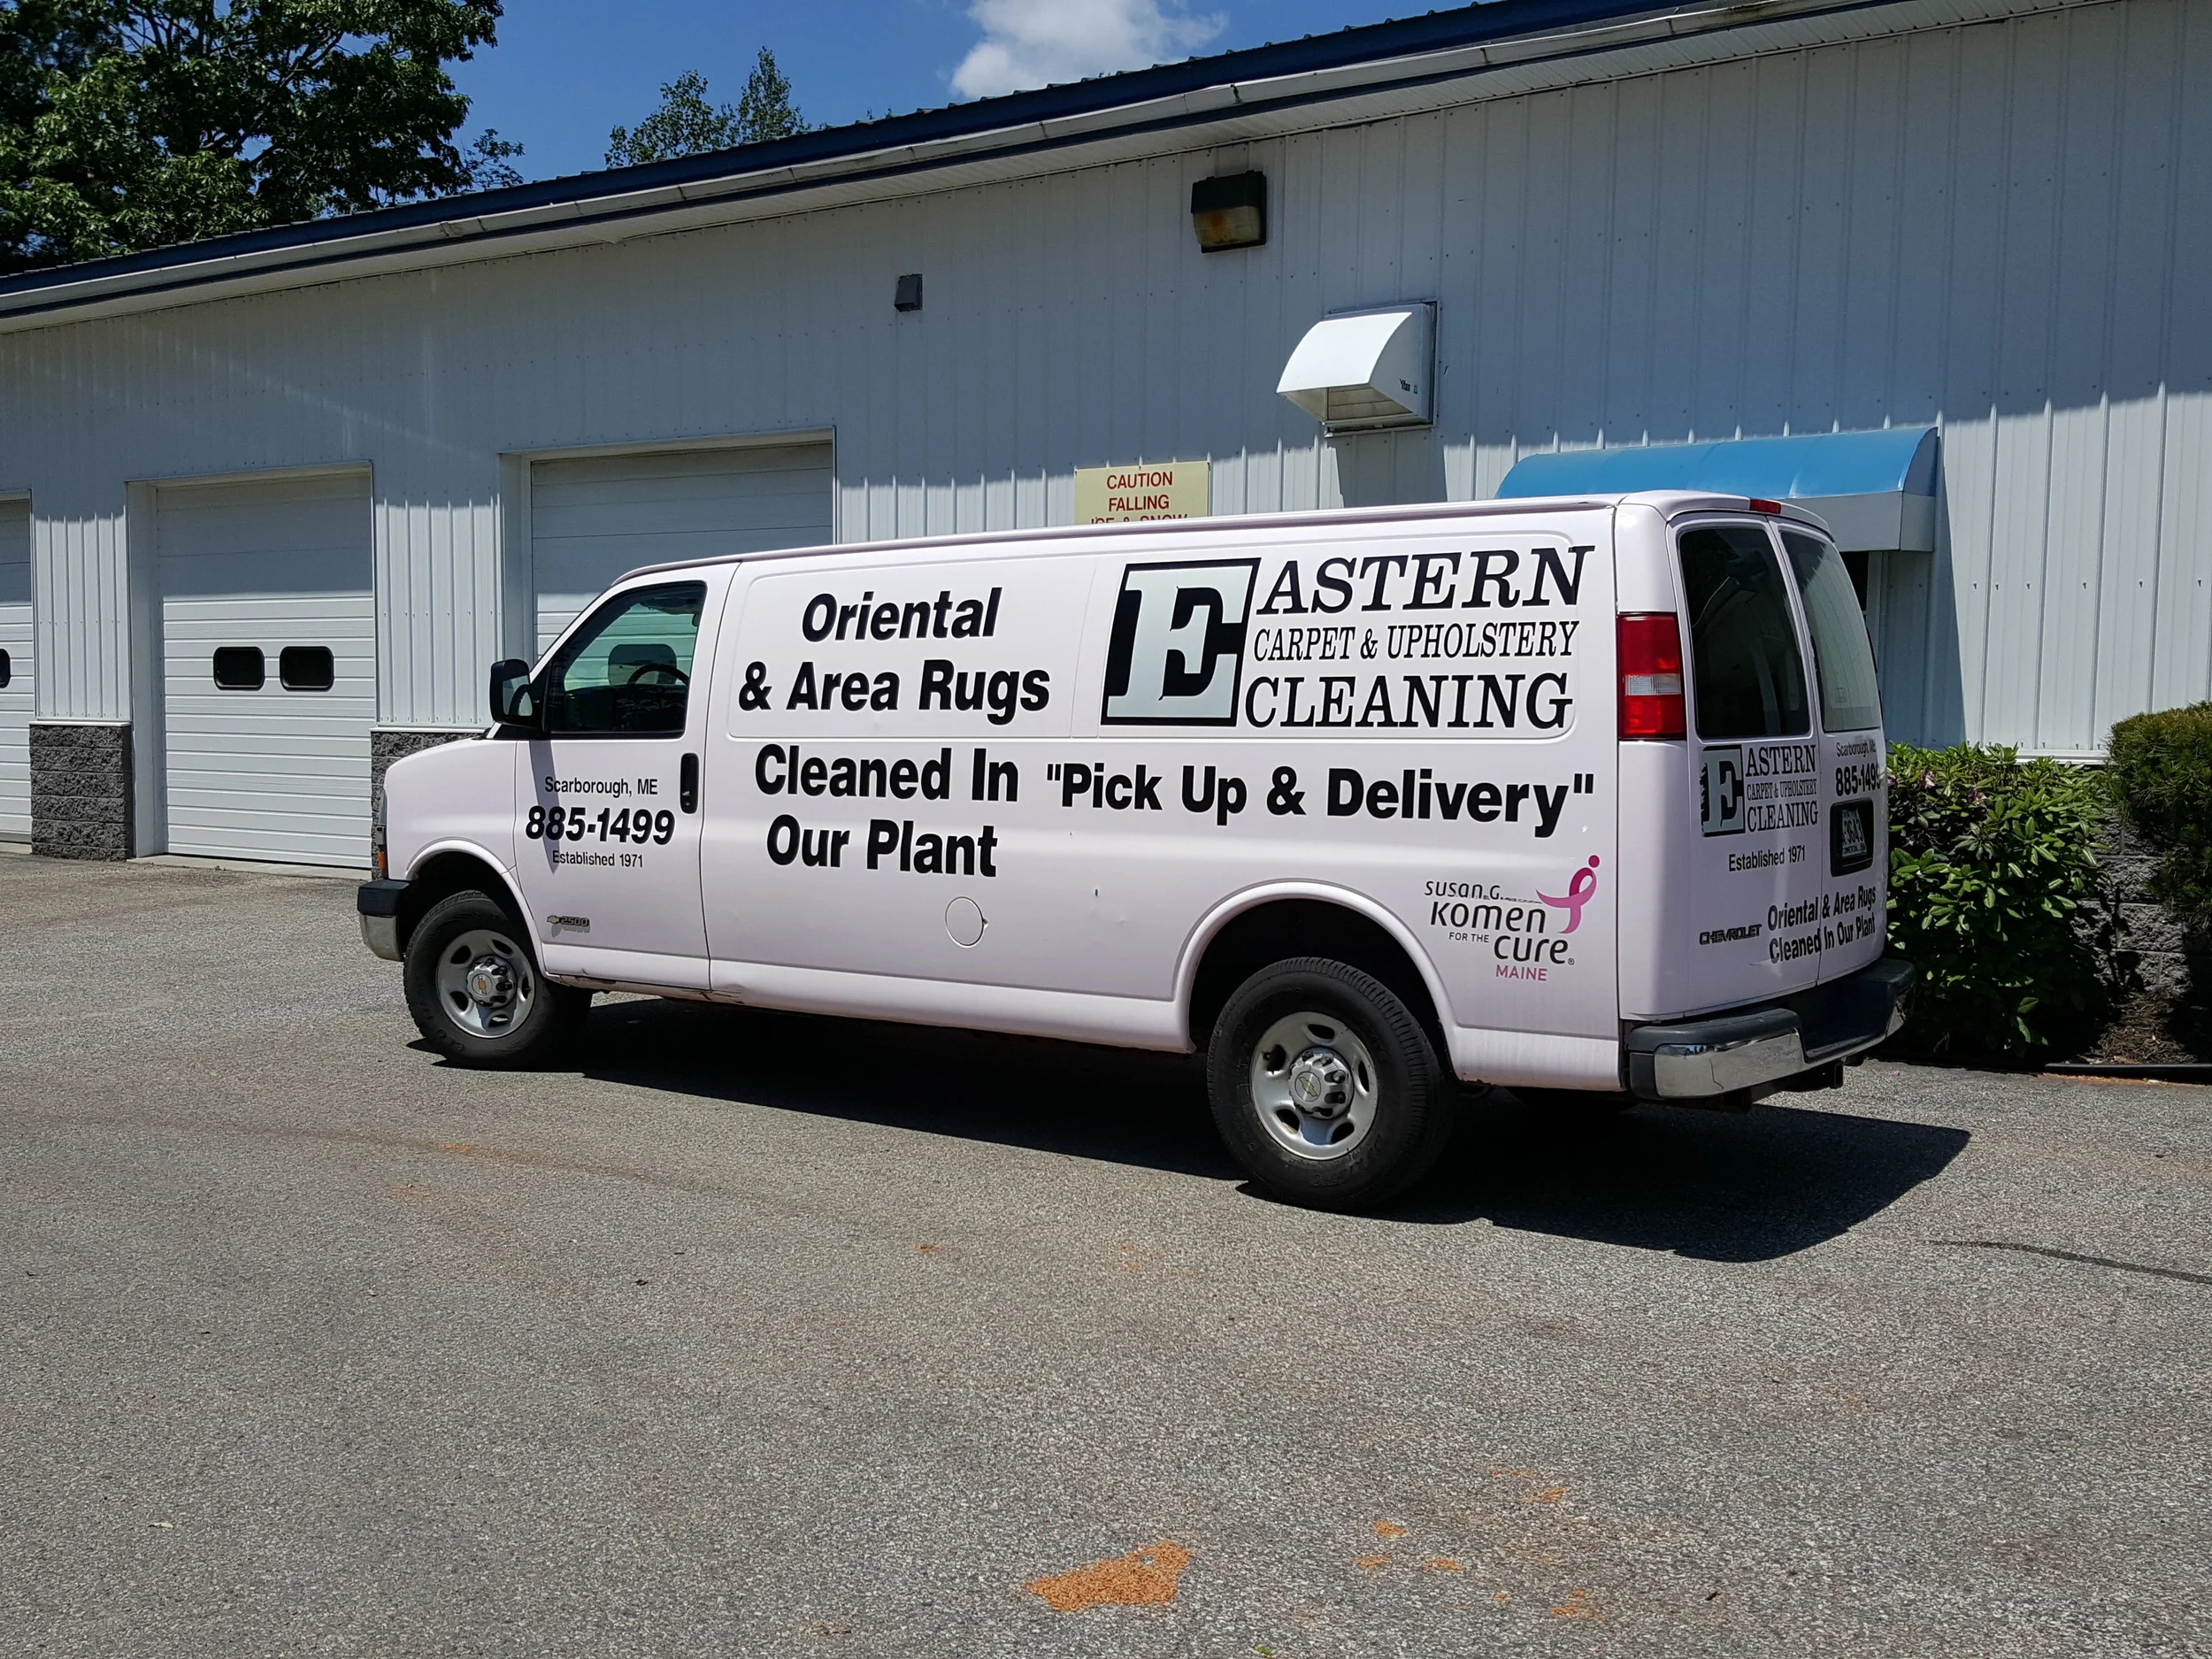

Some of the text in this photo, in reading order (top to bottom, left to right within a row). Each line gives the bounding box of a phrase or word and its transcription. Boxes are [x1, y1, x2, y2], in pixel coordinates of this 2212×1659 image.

[1106, 471, 1173, 490] CAUTION
[1108, 494, 1170, 512] FALLING
[802, 587, 1002, 643] Oriental
[1253, 620, 1579, 662] CARPET & UPHOLSTERY
[738, 659, 1050, 726] & Area Rugs
[1245, 672, 1573, 730] CLEANING
[544, 776, 658, 799] Scarborough, ME
[755, 743, 1019, 803] Cleaned In
[1046, 762, 1594, 839] "Pick Up & Delivery"
[1747, 780, 1773, 802] CARPET
[525, 804, 676, 846] 885-1499
[1747, 800, 1819, 833] CLEANING
[552, 849, 643, 868] Established 1971
[766, 813, 998, 878] Our Plant
[1728, 844, 1806, 872] Established 1971
[559, 916, 590, 927] 2500
[1767, 885, 1877, 932] Oriental & Area Rugs
[1448, 931, 1469, 941] FOR
[1471, 933, 1490, 943] THE
[1699, 924, 1763, 946] CHEVROLET
[1769, 911, 1877, 964] Cleaned In Our Plant
[1495, 964, 1548, 982] MAINE
